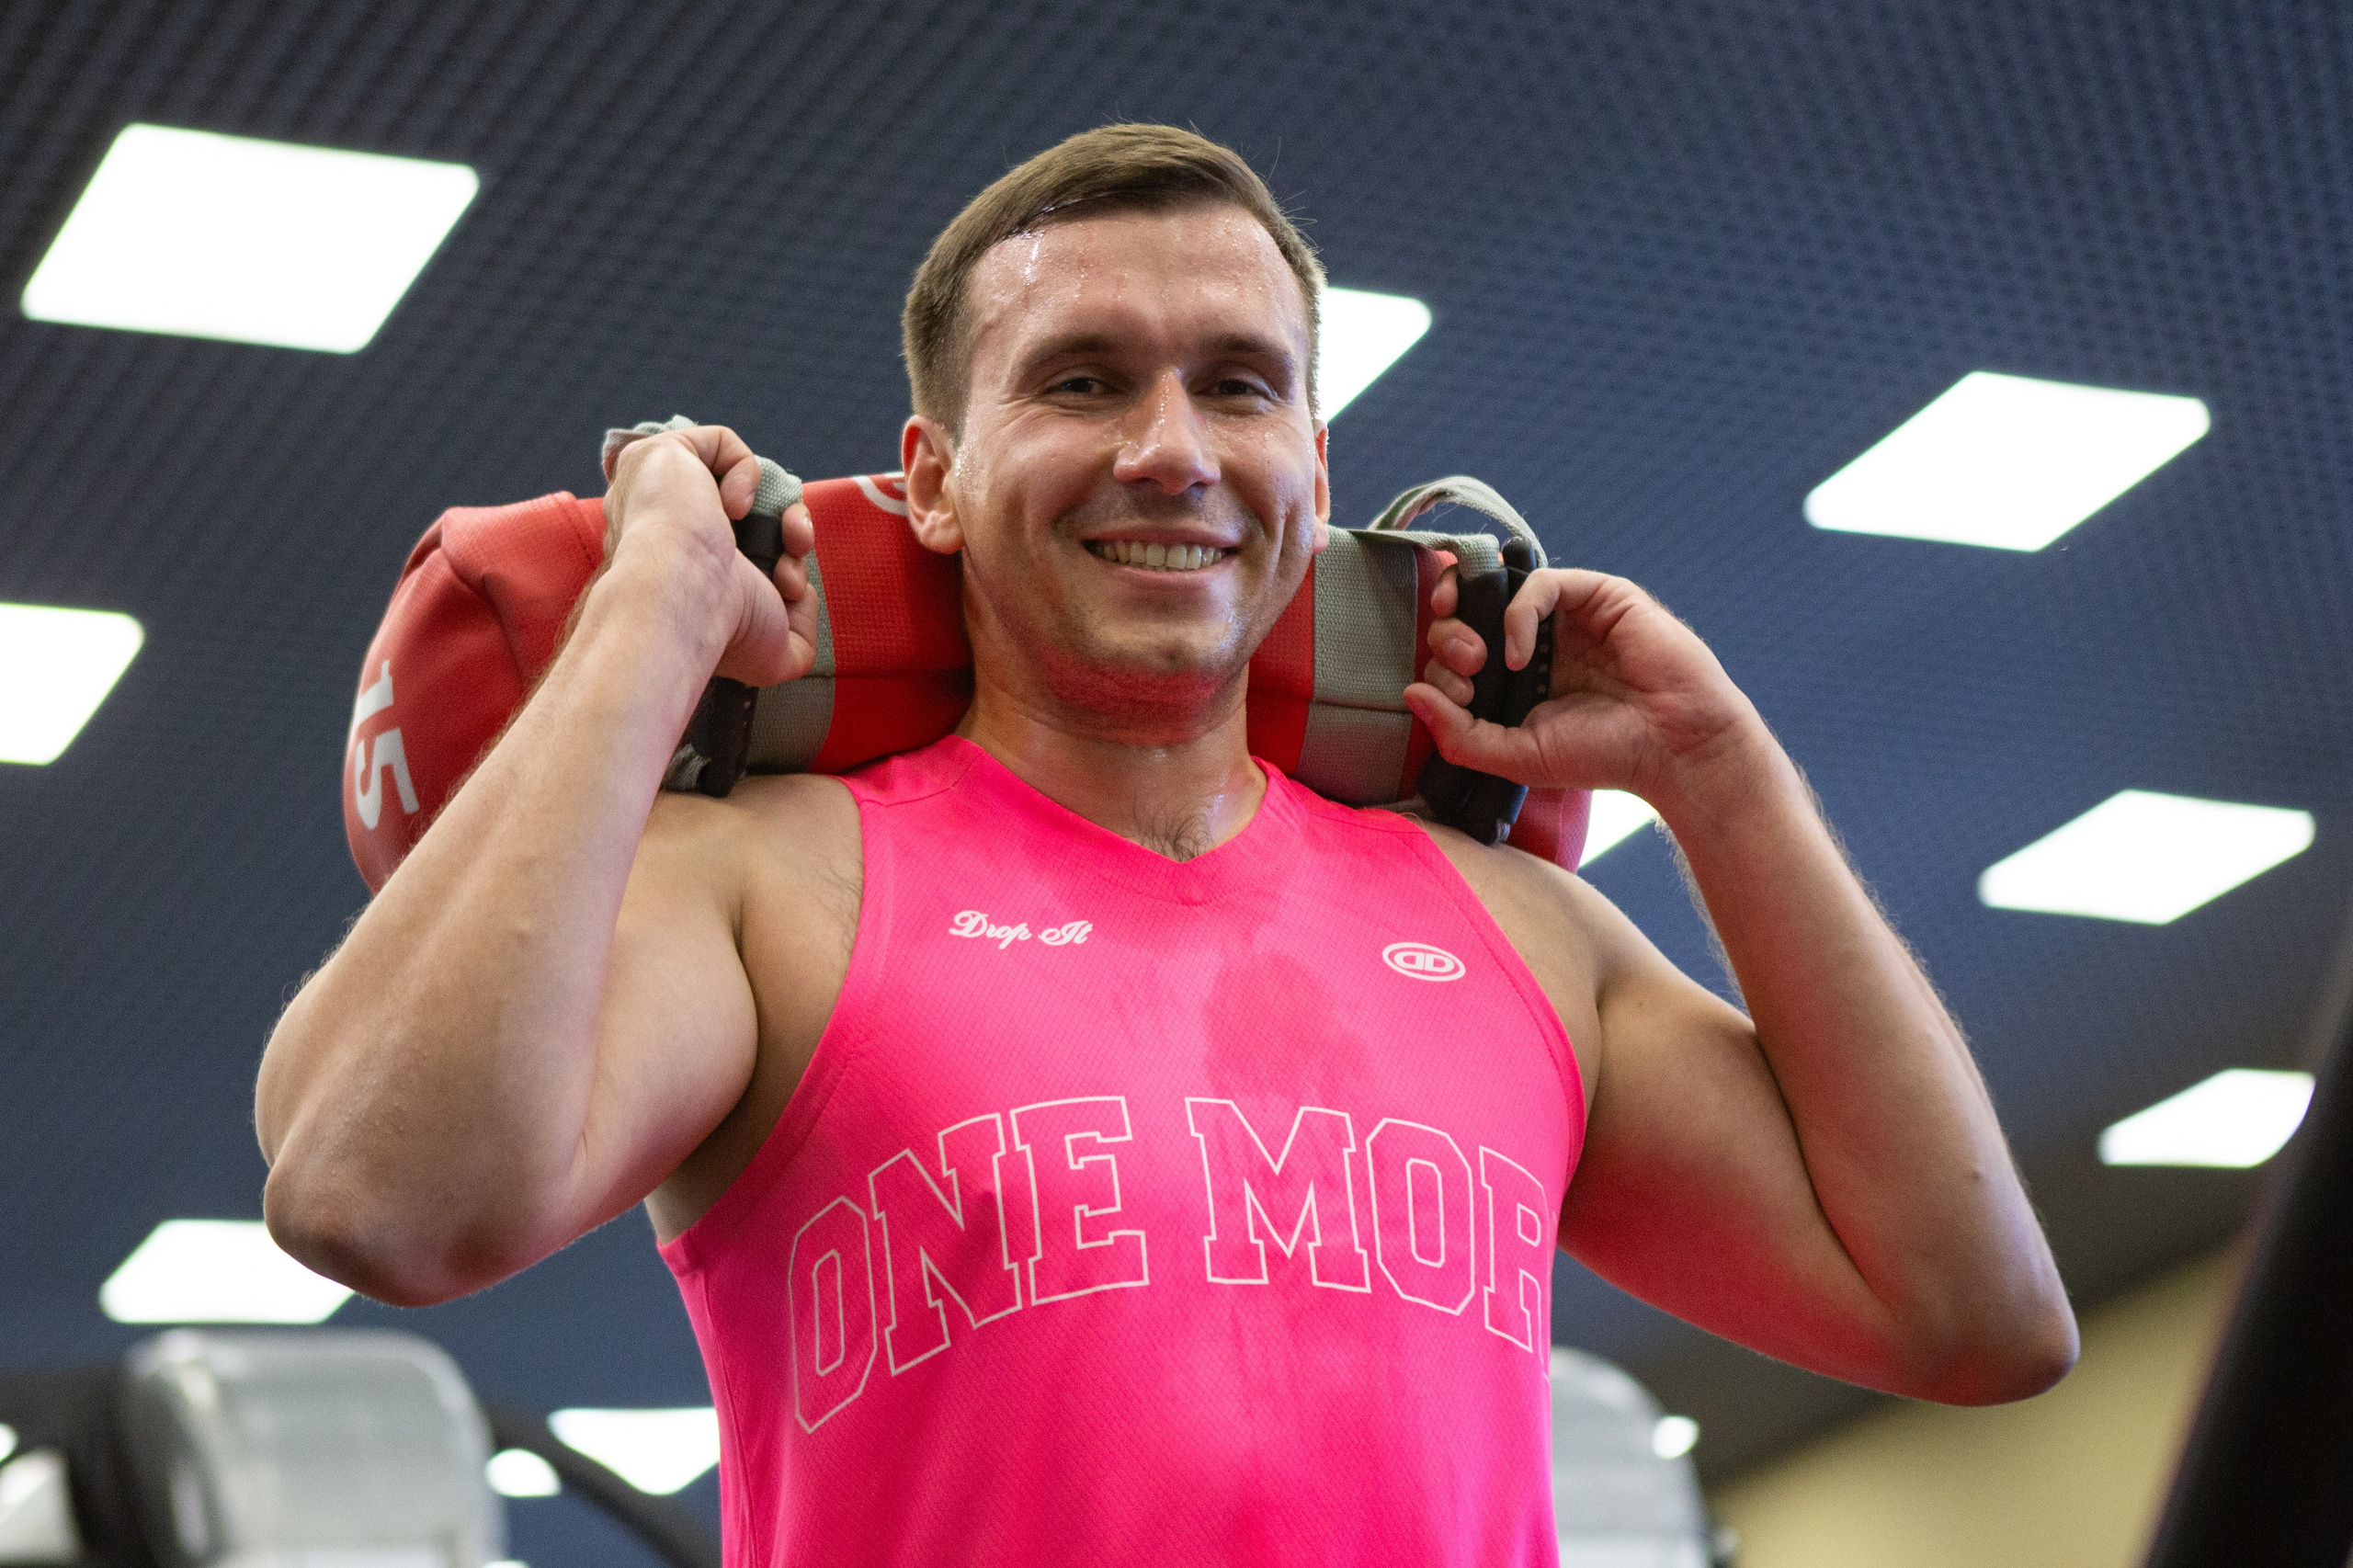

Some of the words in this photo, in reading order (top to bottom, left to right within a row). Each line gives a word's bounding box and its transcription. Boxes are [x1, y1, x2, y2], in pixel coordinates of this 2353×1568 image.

[352, 659, 420, 830] 15
[949, 910, 1032, 949] Drop
[1038, 920, 1094, 946] It
[788, 1096, 1150, 1434] ONE
[1185, 1097, 1557, 1384] MOR
